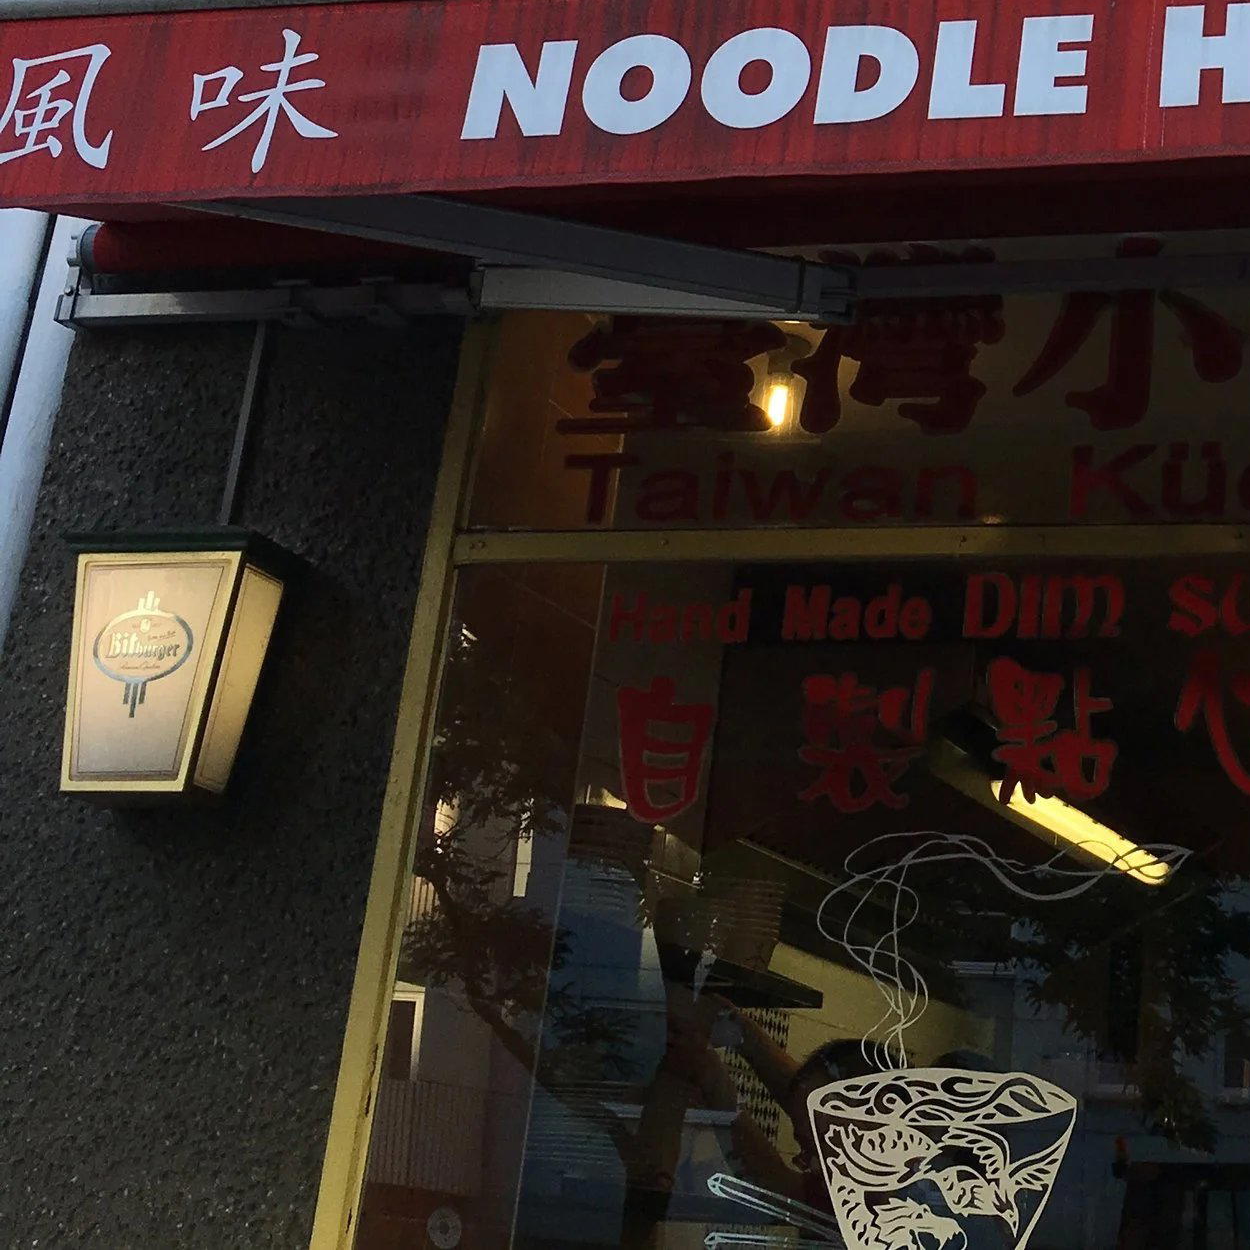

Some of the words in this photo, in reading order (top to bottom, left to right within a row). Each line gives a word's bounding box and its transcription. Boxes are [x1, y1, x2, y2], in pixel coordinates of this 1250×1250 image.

[0, 30, 339, 173] 風味
[461, 14, 1093, 139] NOODLE
[564, 452, 978, 524] Taiwan
[104, 632, 180, 661] Bitburger
[610, 587, 750, 643] Hand
[781, 585, 933, 641] Made
